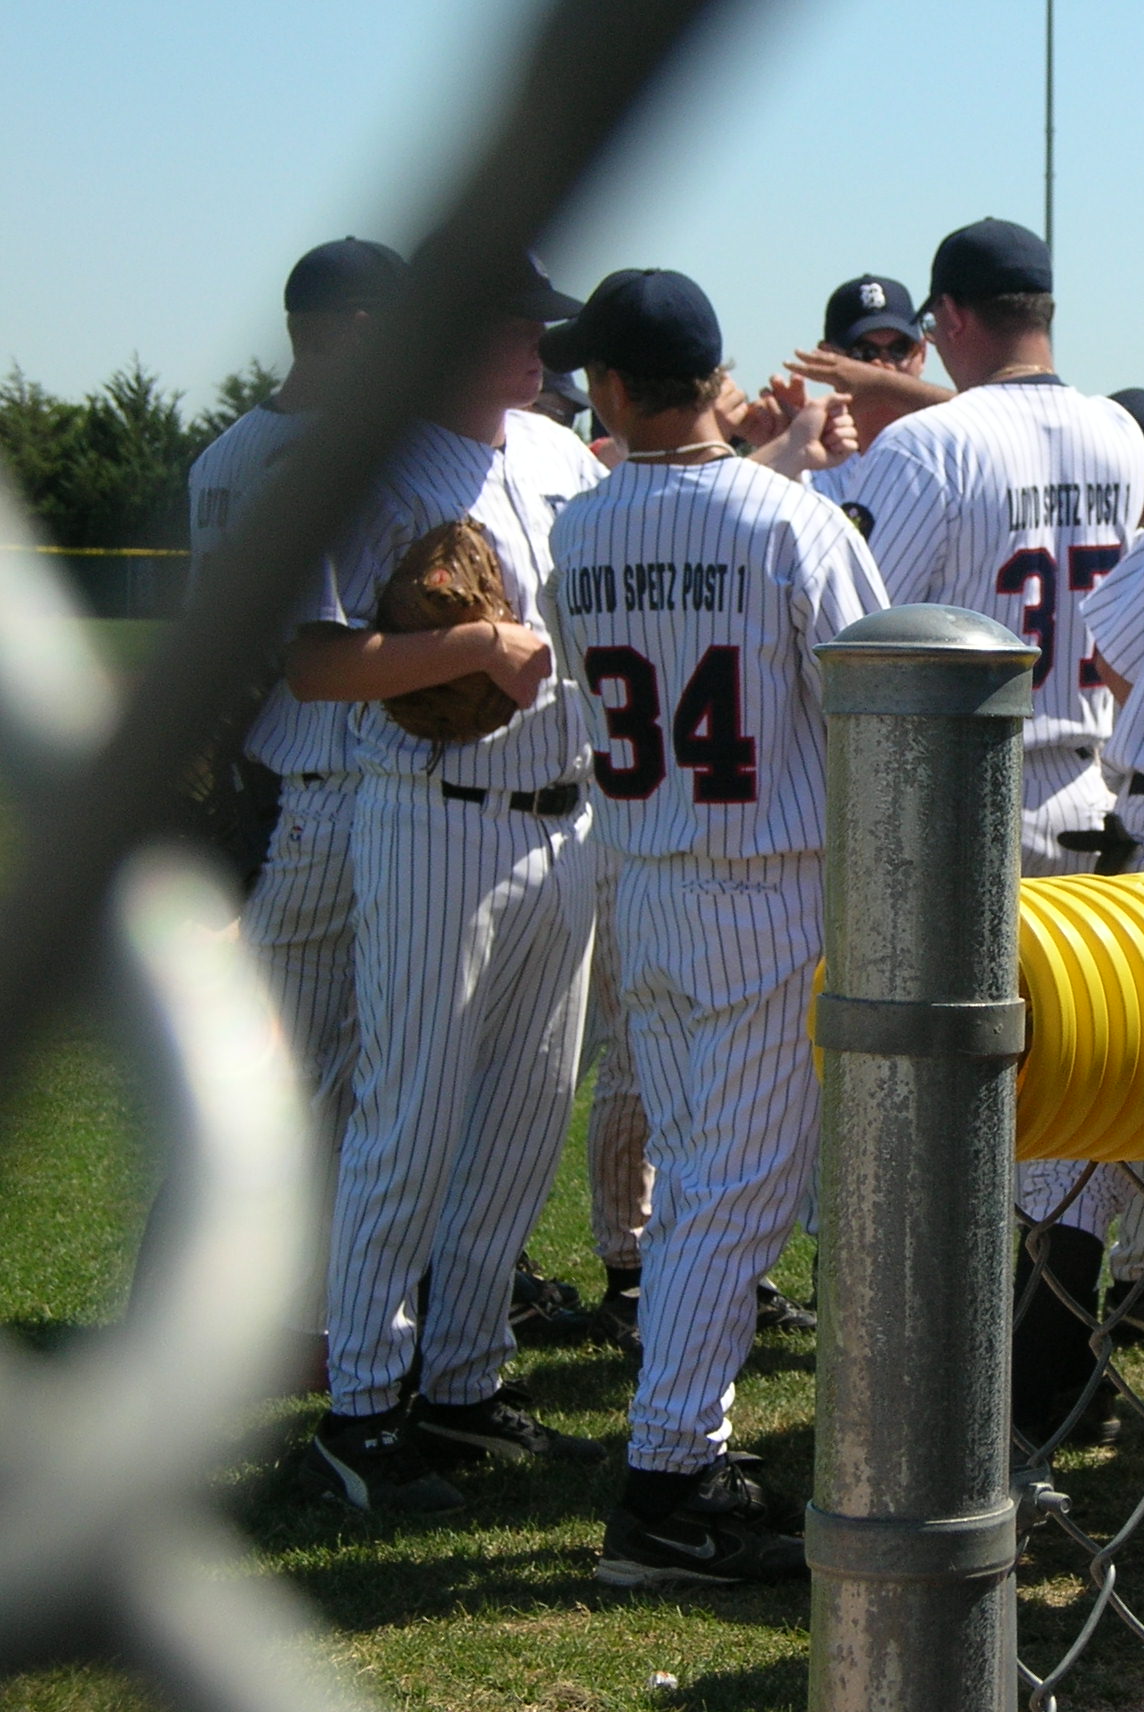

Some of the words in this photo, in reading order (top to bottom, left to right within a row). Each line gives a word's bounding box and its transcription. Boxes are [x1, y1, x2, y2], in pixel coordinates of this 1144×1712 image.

[1006, 484, 1040, 532] LLOYD
[1044, 483, 1081, 527] SPETZ
[1087, 482, 1120, 526] POST
[565, 564, 617, 617] LLOYD
[624, 562, 676, 612] SPETZ
[682, 562, 728, 612] POST
[737, 564, 746, 614] 1
[583, 644, 758, 805] 34
